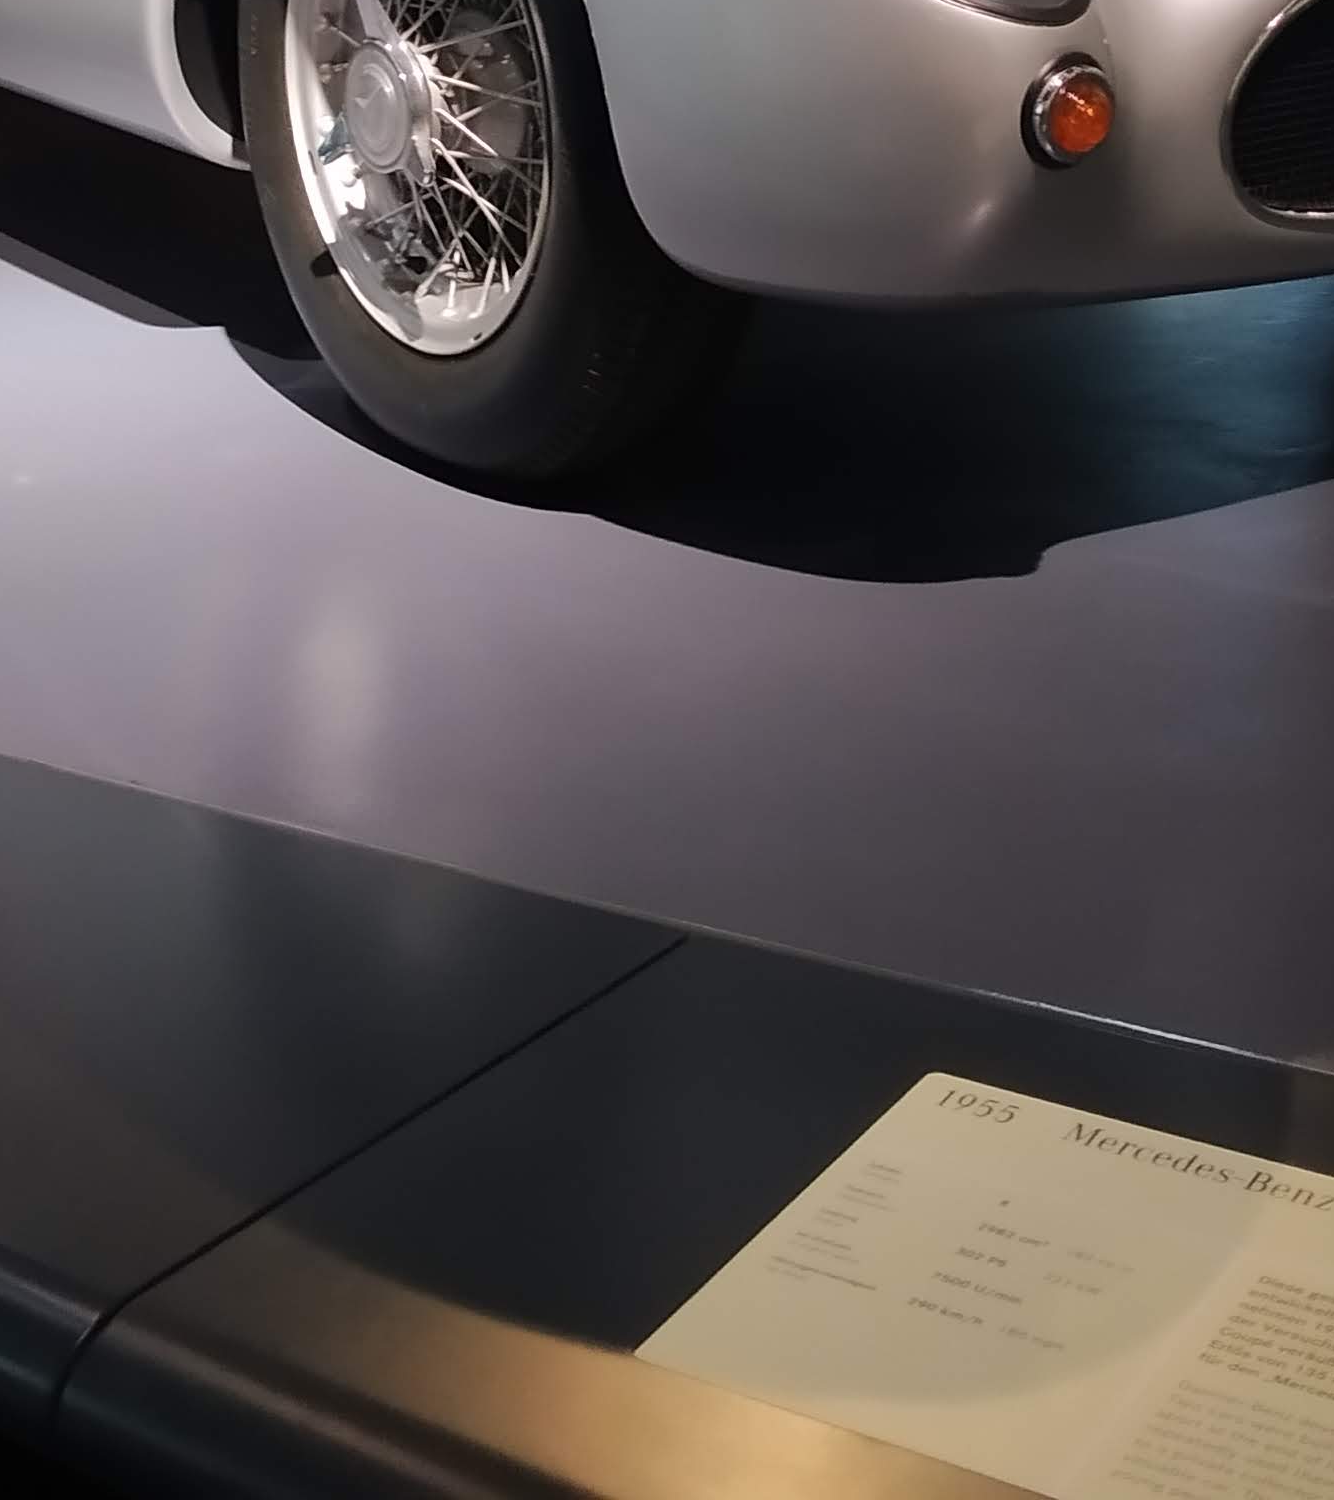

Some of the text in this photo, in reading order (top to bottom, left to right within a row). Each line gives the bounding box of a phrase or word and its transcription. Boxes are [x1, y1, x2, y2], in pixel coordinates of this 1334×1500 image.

[939, 1091, 1019, 1123] 1955
[1228, 1316, 1256, 1326] der
[1219, 1327, 1275, 1348] Coupé
[1198, 1352, 1223, 1364] für
[1227, 1364, 1259, 1376] den
[1257, 1356, 1287, 1369] von
